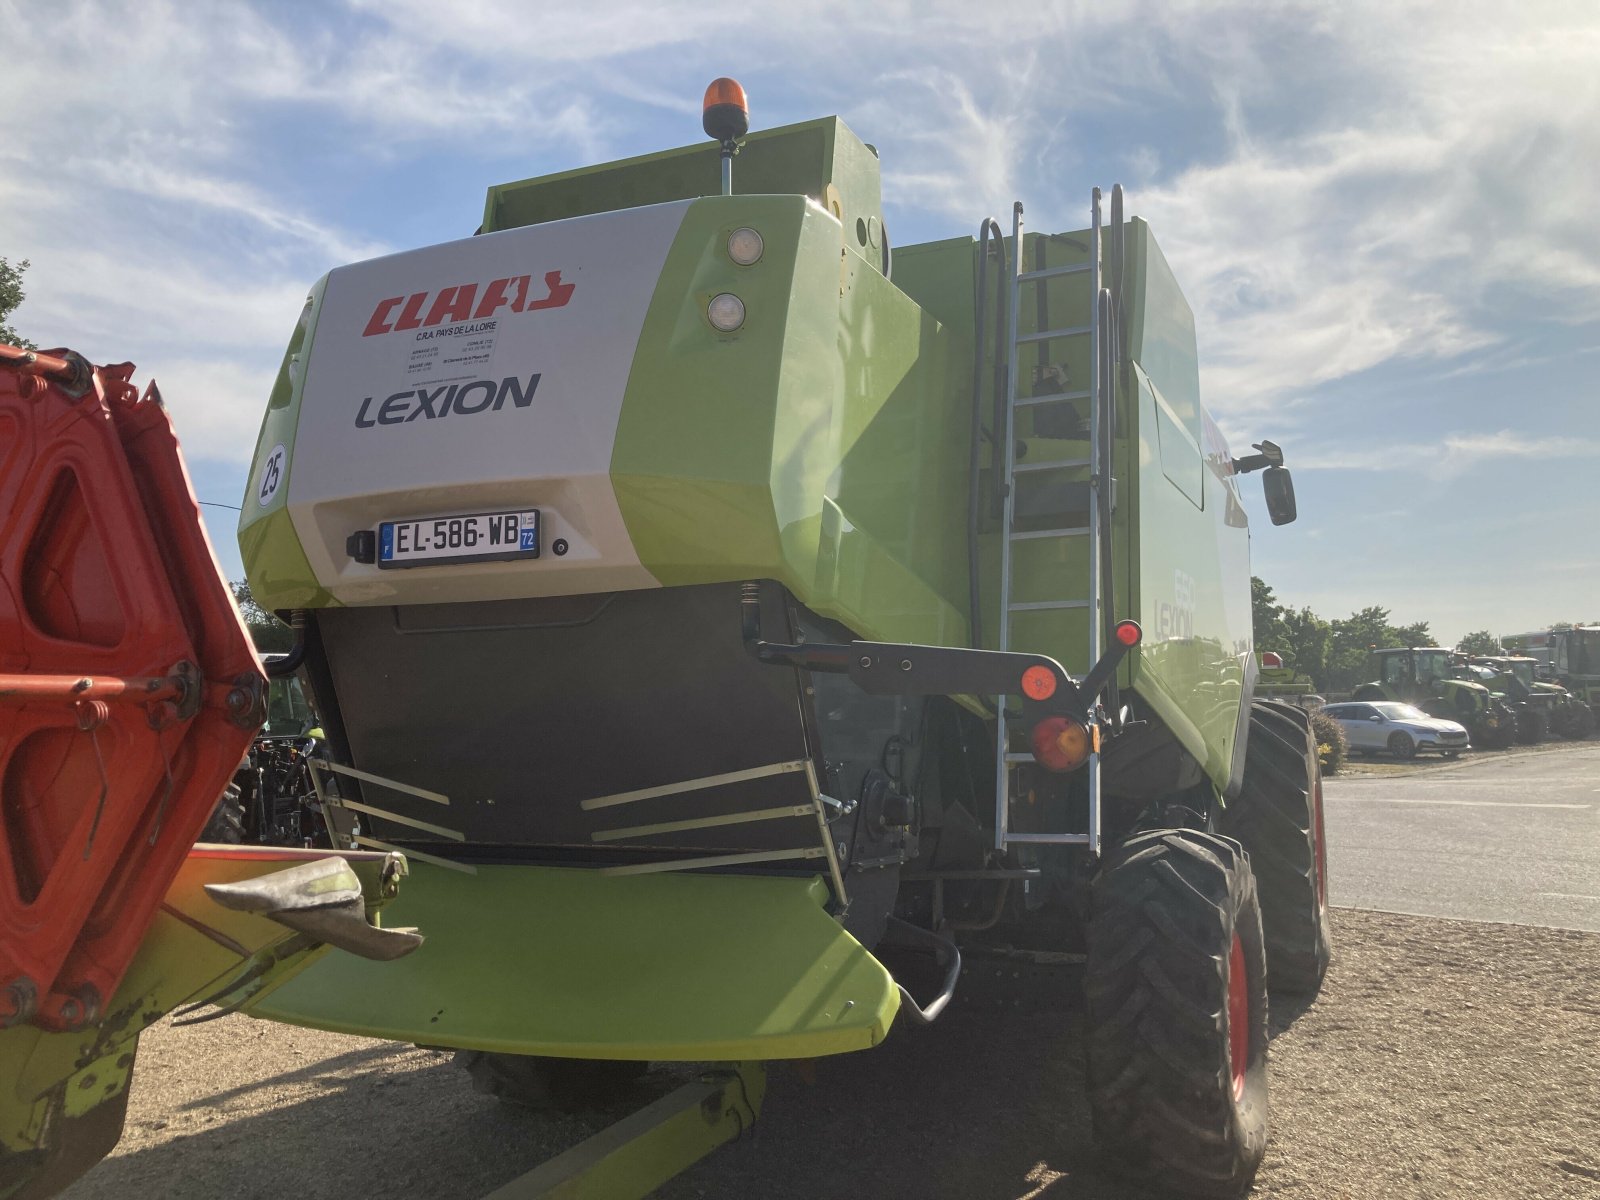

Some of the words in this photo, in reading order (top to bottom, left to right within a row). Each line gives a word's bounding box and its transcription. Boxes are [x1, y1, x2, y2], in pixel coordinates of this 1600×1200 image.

[362, 270, 576, 337] CLAAS
[435, 327, 453, 338] PAYS
[454, 326, 464, 335] DE
[464, 324, 476, 333] LA
[475, 321, 497, 332] LOIRE
[354, 373, 542, 429] LEXION
[261, 452, 282, 498] 25
[397, 515, 519, 553] EL-586-WB
[521, 532, 534, 546] 72
